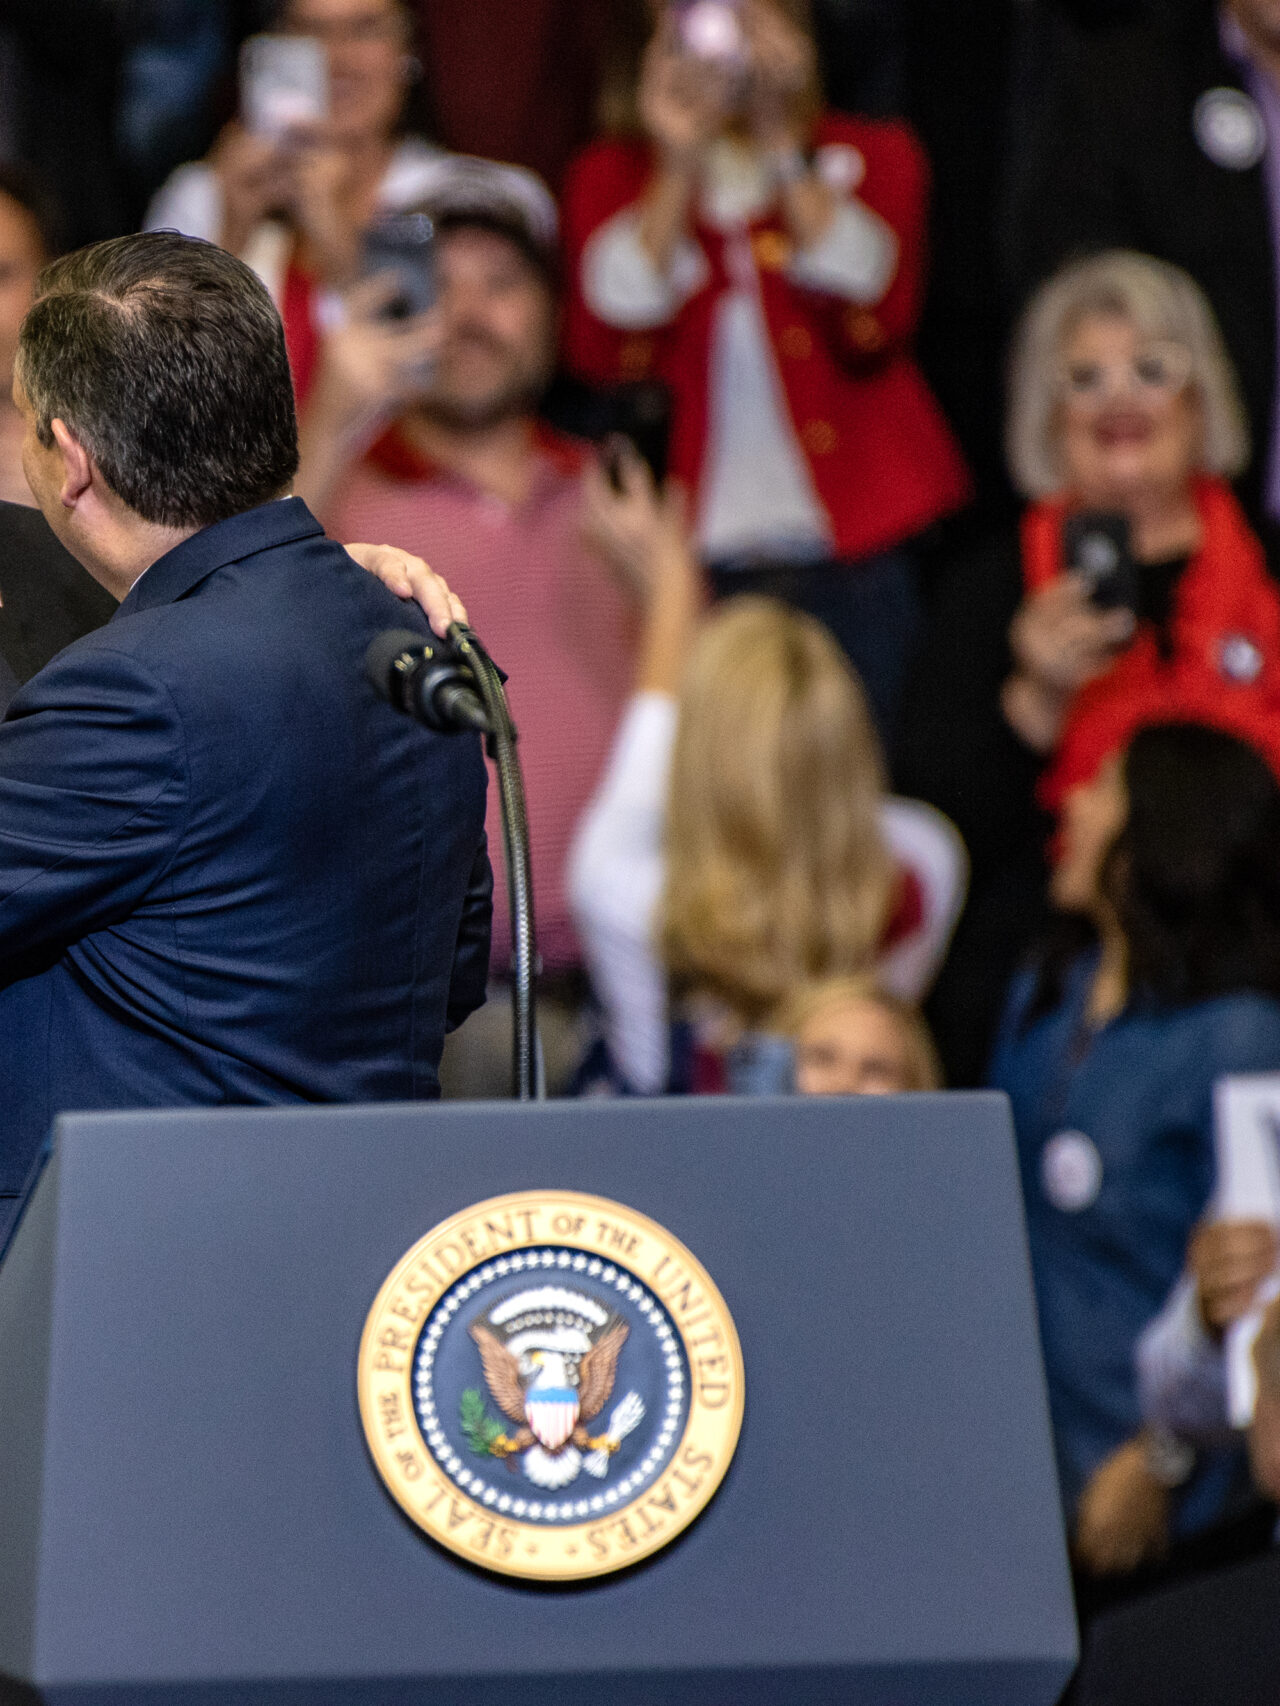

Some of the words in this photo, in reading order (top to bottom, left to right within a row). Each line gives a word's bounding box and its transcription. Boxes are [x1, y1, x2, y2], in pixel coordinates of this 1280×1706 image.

[552, 1214, 585, 1236] OF
[598, 1221, 642, 1260] THE
[374, 1208, 542, 1373] PRESIDENT
[650, 1255, 729, 1411] UNITED
[381, 1392, 406, 1439] THE
[396, 1450, 423, 1482] OF
[426, 1480, 520, 1559] SEAL
[587, 1445, 713, 1561] STATES
